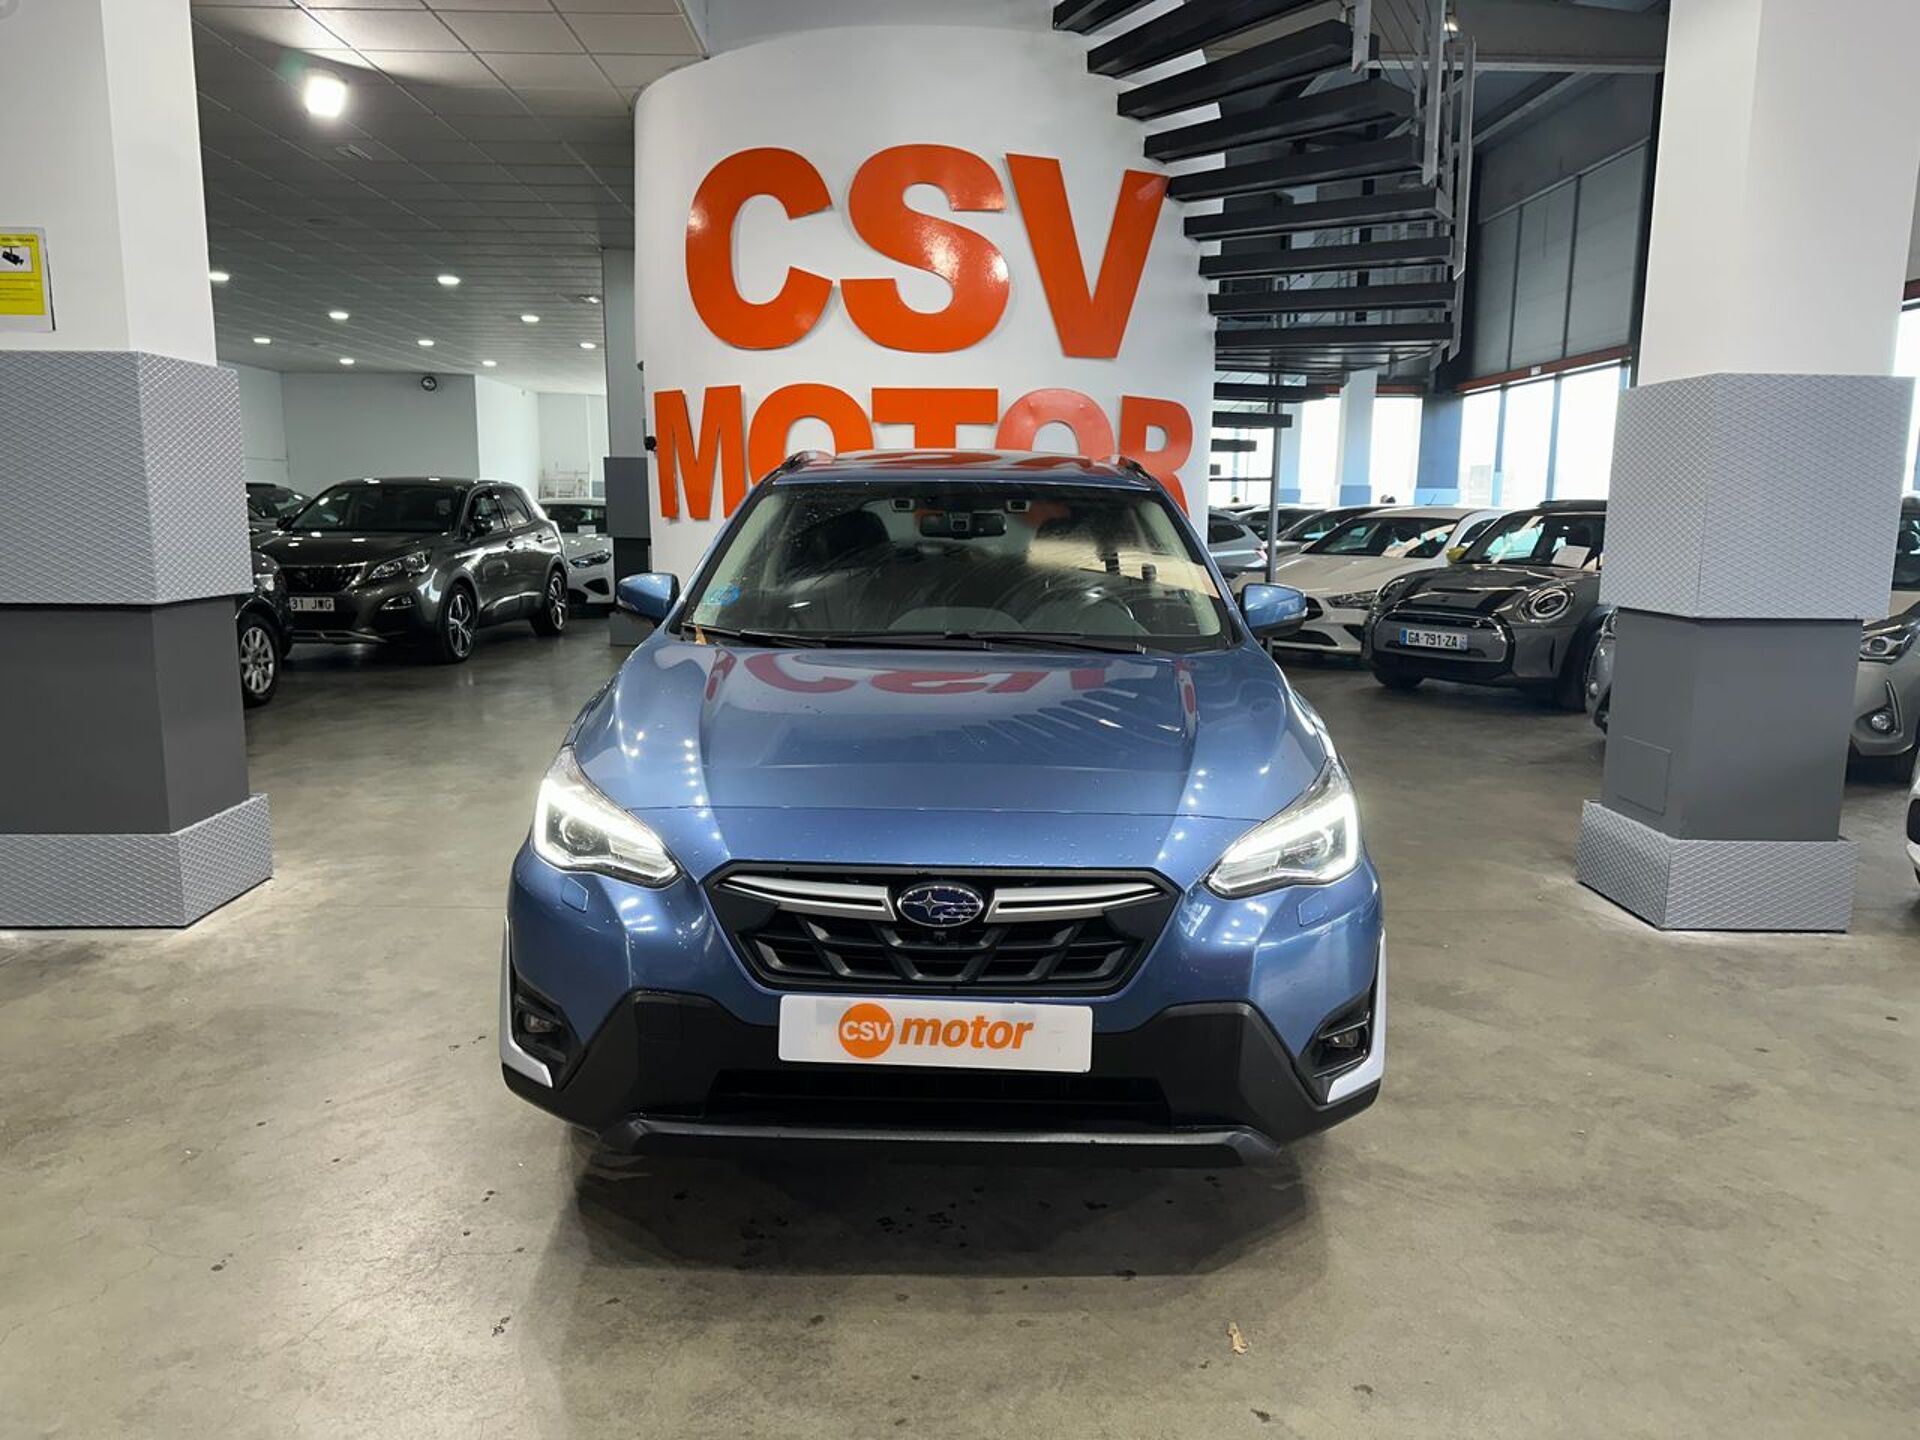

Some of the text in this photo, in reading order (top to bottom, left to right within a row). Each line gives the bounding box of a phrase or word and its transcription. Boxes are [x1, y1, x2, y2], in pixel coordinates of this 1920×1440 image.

[686, 144, 1169, 359] CSV
[842, 1015, 1034, 1049] CSV motor
